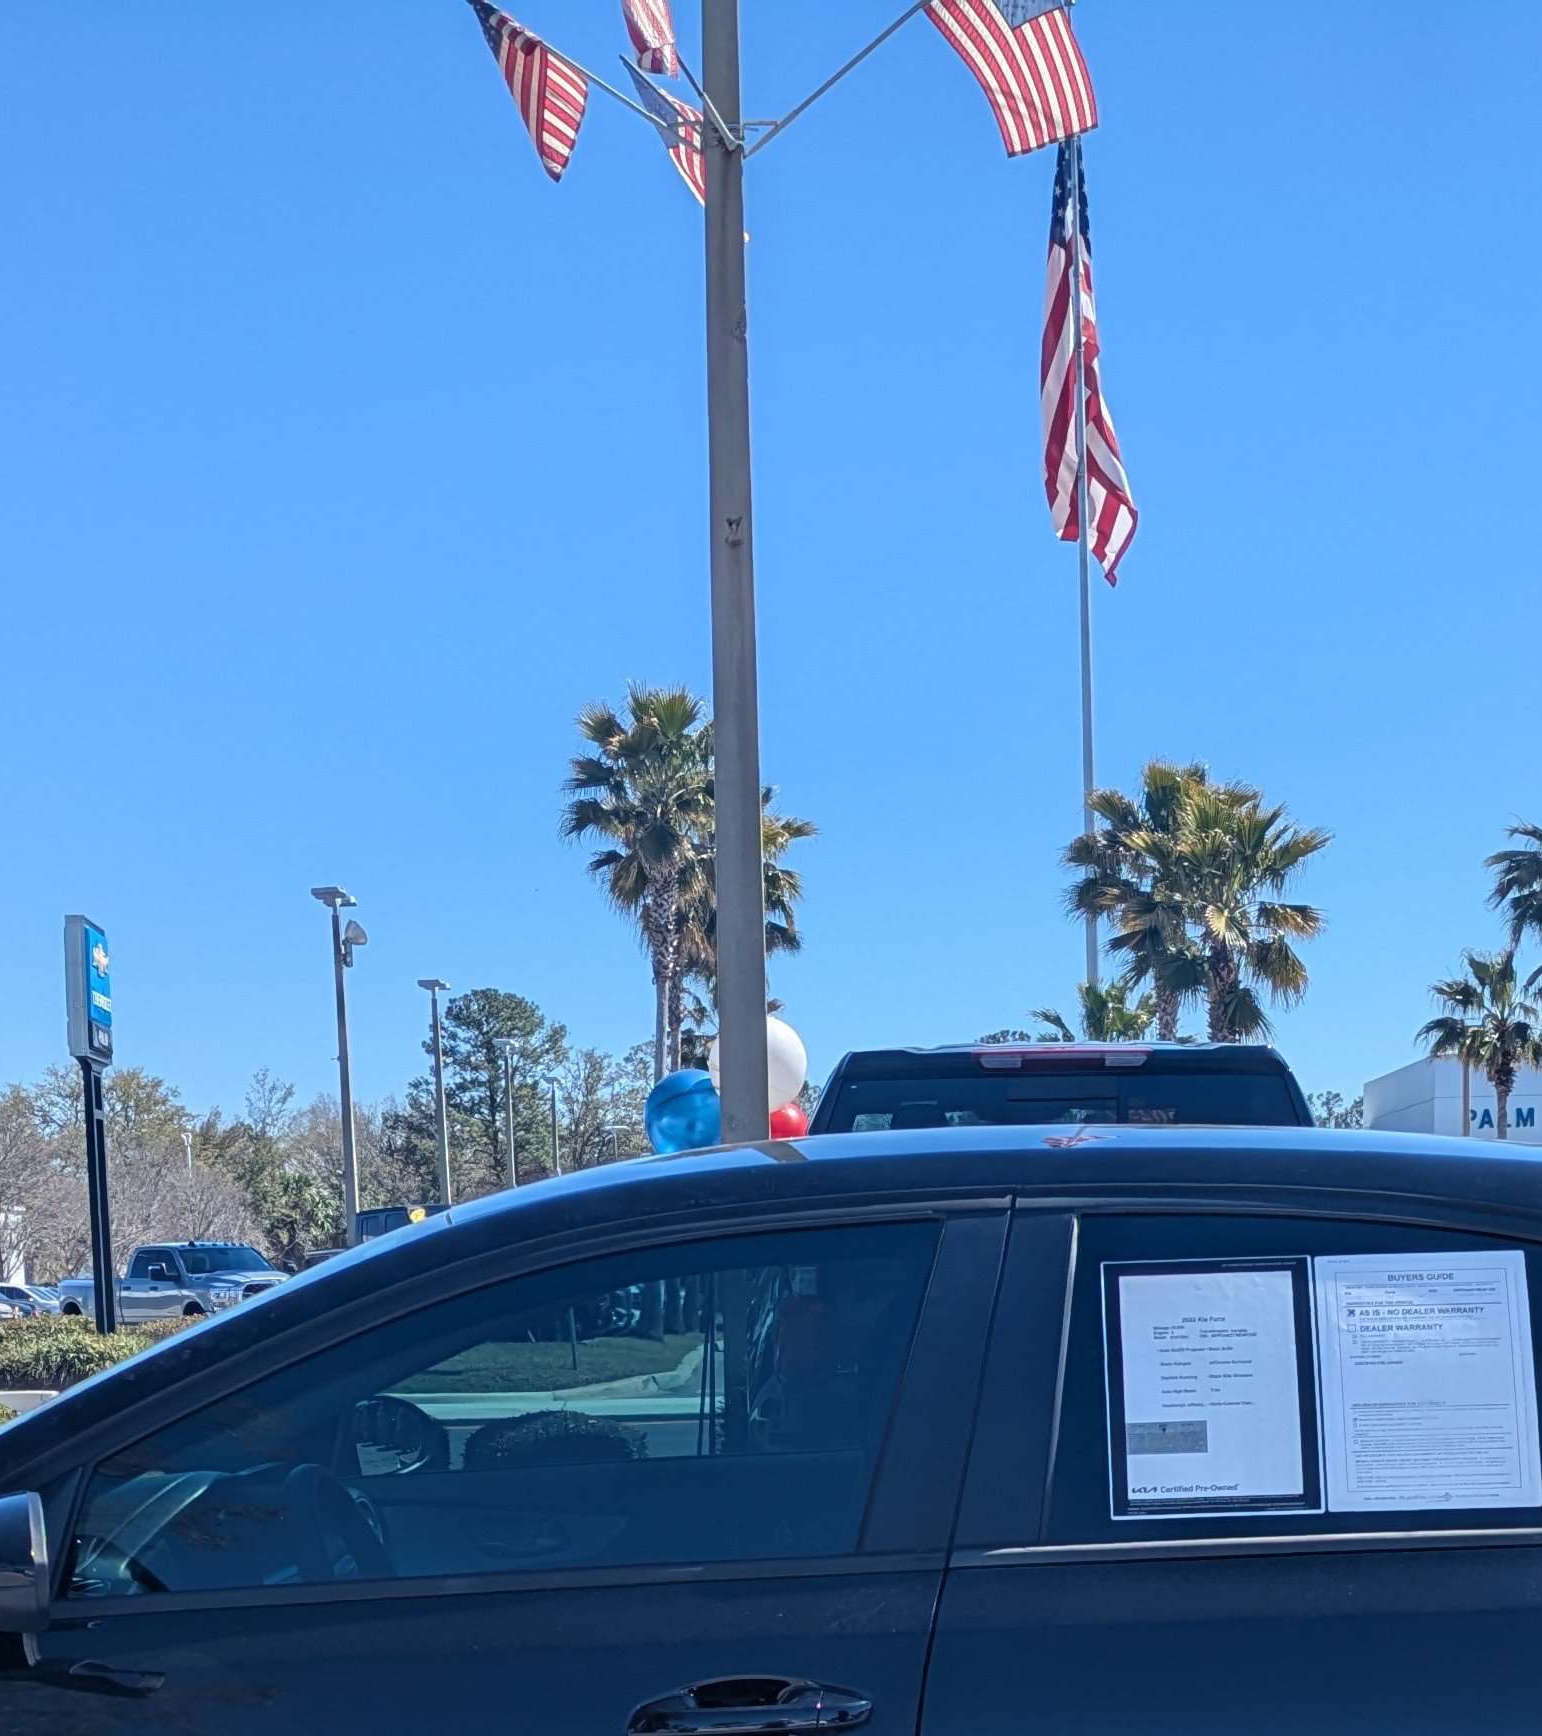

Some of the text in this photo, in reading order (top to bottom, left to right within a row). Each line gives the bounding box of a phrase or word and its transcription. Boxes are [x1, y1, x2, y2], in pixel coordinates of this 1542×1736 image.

[1465, 1107, 1535, 1129] PAM
[1387, 1272, 1455, 1282] BUYERS GUIDE
[1359, 1308, 1370, 1316] AS
[1372, 1308, 1381, 1316] IS
[1387, 1307, 1399, 1315] NO
[1401, 1307, 1436, 1315] DEALER
[1437, 1306, 1485, 1314] WARRANTY
[1360, 1323, 1443, 1333] DEALER WARRANTY
[1160, 1485, 1194, 1494] Certified
[1195, 1484, 1238, 1492] Pre-Owned
